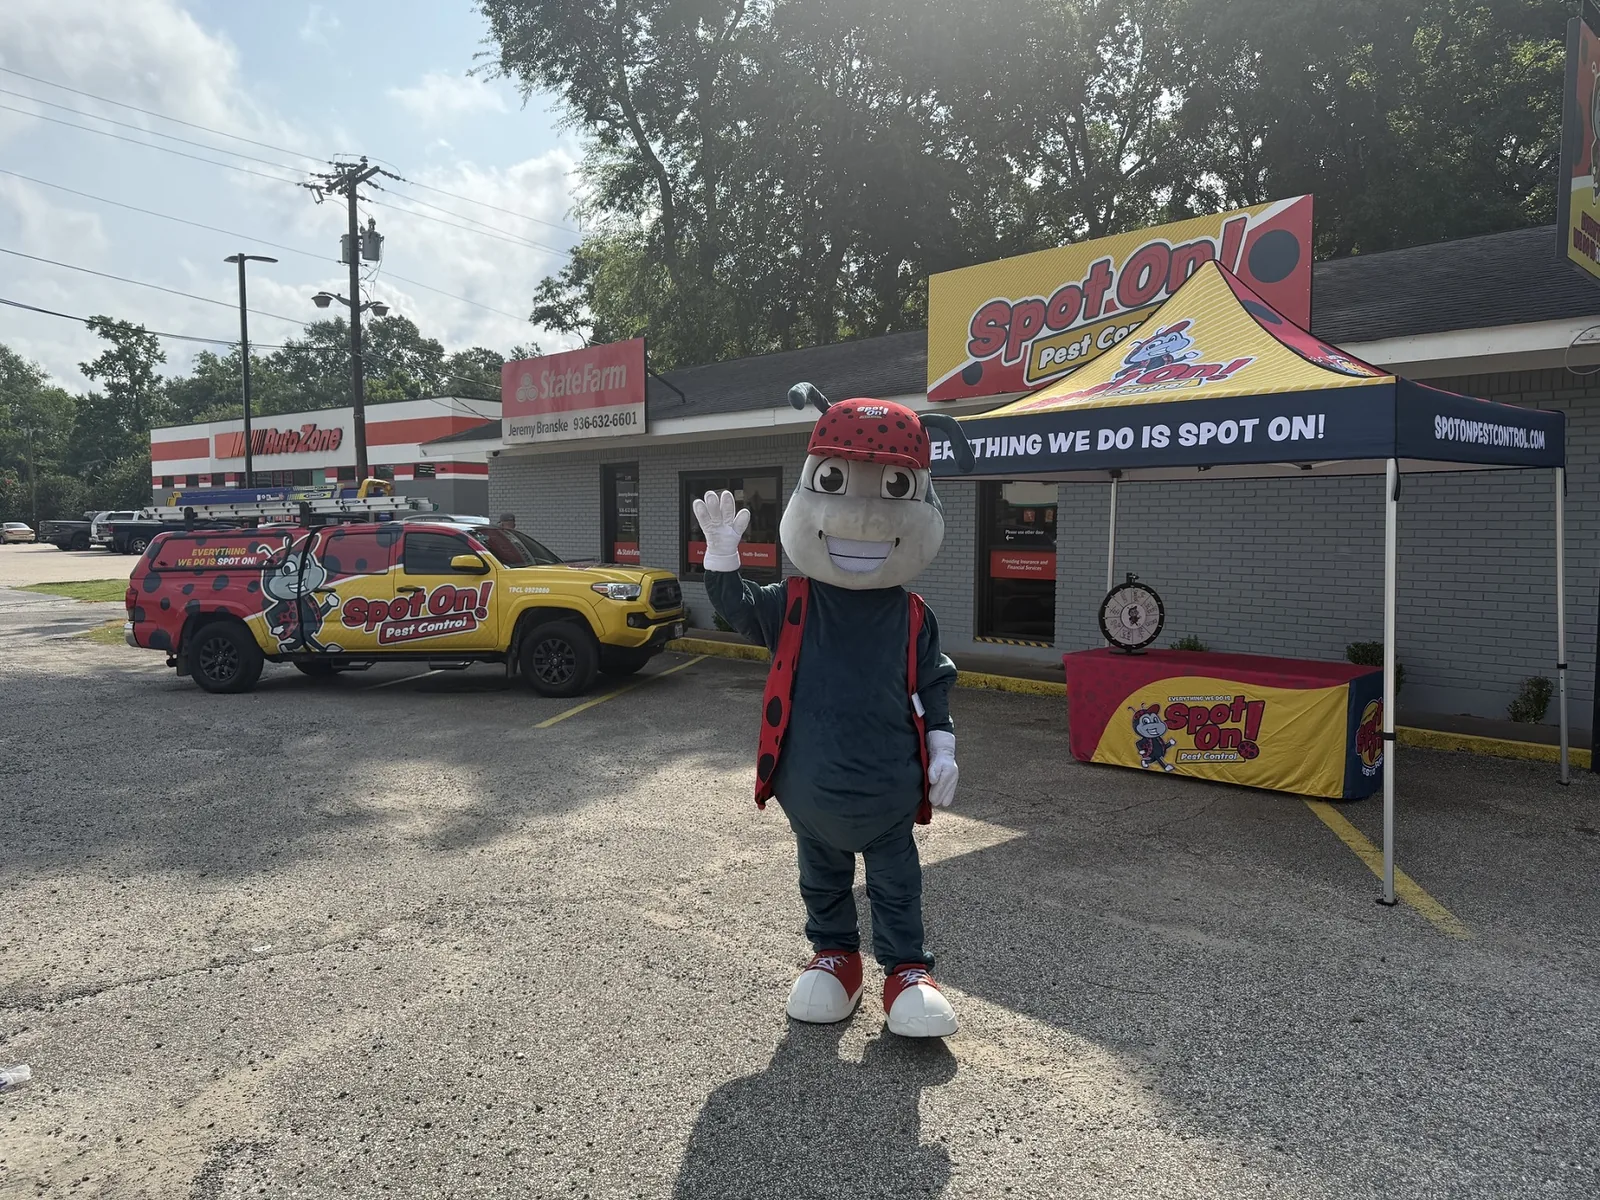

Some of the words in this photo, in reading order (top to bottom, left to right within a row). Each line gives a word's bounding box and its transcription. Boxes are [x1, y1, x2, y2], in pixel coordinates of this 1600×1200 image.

[968, 258, 1113, 363] Spot
[1039, 334, 1092, 369] Pest
[263, 423, 343, 455] AutoZone
[508, 424, 536, 438] Jeremy
[537, 418, 568, 434] Branske
[573, 411, 637, 431] 936-632-6601
[930, 433, 1042, 461] ERTHING
[1048, 430, 1091, 454] WE
[1097, 427, 1134, 450] DO
[1141, 425, 1171, 449] IS
[1178, 418, 1260, 447] SPOT
[1267, 414, 1326, 442] ON!
[1434, 414, 1546, 450] SPOTONPESTCONTROL.COM
[178, 558, 192, 566] WE
[193, 558, 205, 566] DO
[217, 557, 240, 566] SPOT
[241, 556, 257, 565] ON!
[191, 547, 247, 556] EVERYTHING
[342, 587, 427, 632] Spot
[428, 581, 493, 620] On!
[386, 625, 415, 638] Pest
[418, 616, 467, 632] Control
[1164, 696, 1247, 735] Spot
[1181, 752, 1202, 760] Pest
[1203, 752, 1238, 760] Control
